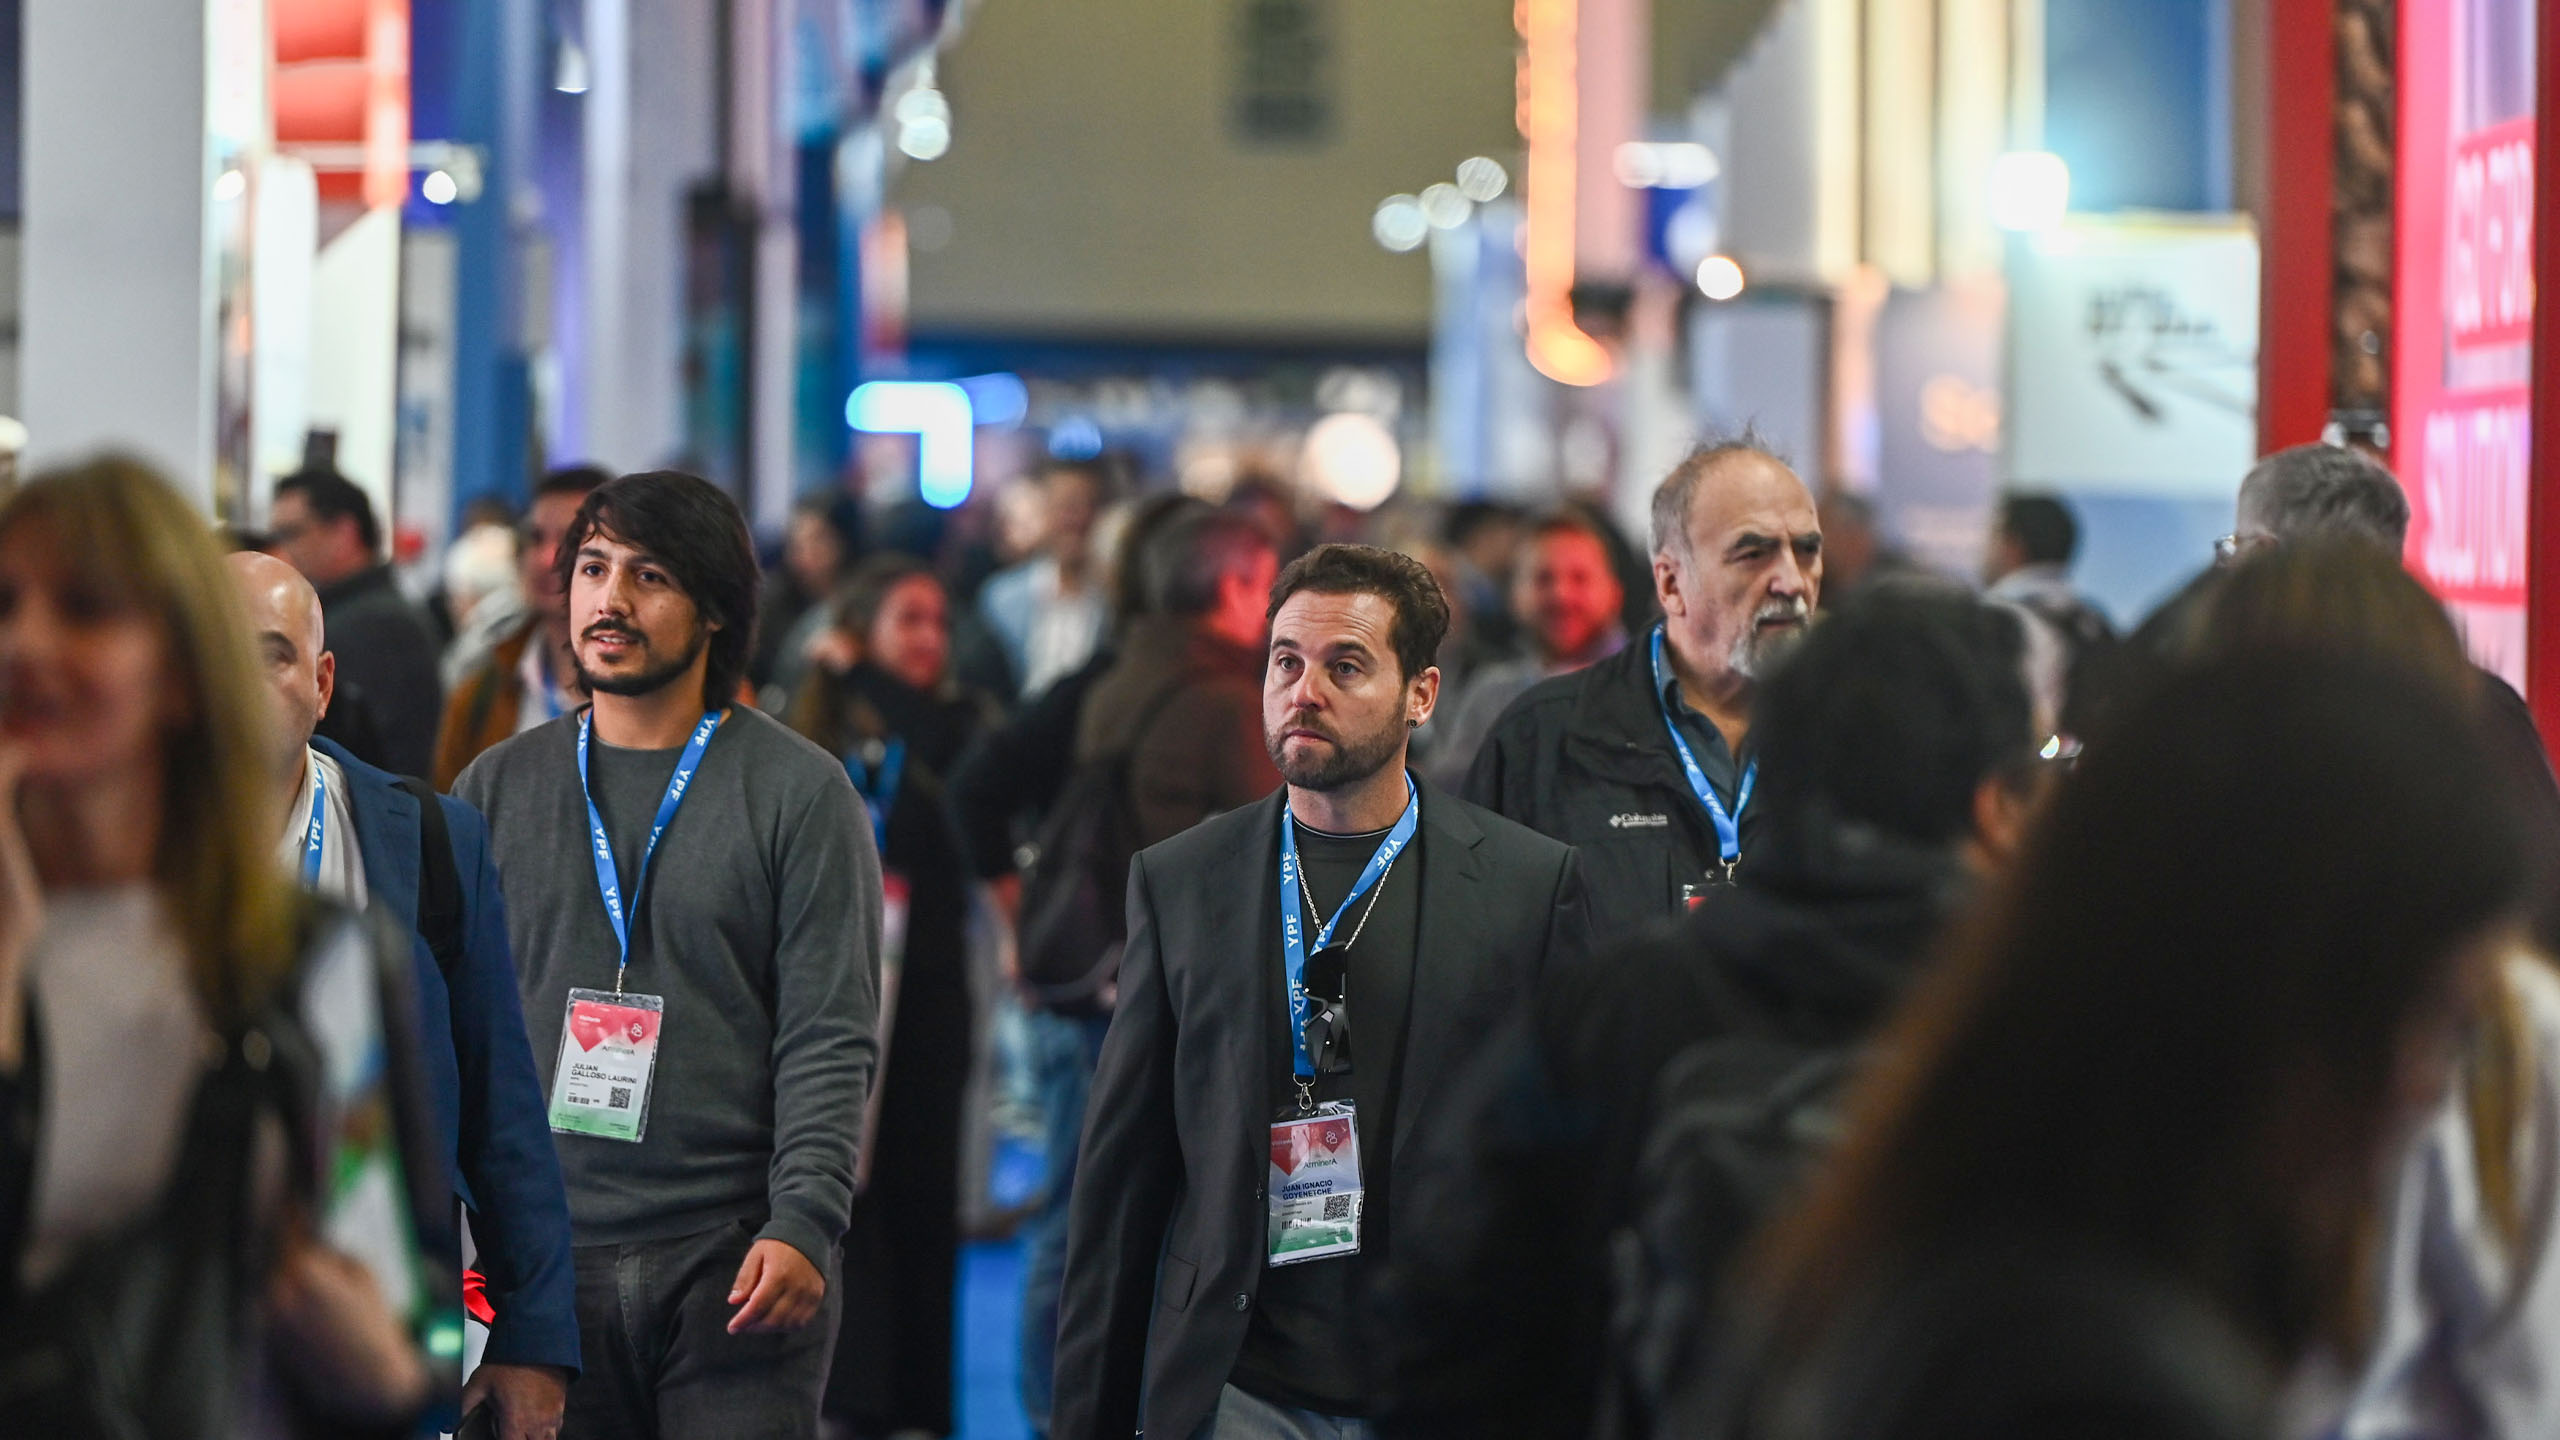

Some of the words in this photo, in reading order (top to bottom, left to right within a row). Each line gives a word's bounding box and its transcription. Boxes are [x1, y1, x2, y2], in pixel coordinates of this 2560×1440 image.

[694, 719, 716, 746] YPF
[671, 769, 691, 801] YPF
[309, 817, 322, 852] YPF
[595, 827, 609, 860] YPF
[1283, 851, 1294, 885] YPF
[1377, 838, 1402, 870] YPF
[605, 886, 622, 920] YPF
[1287, 913, 1299, 949] YPF
[1291, 978, 1304, 1016] YPF
[571, 1069, 607, 1080] GALLOSO
[607, 1074, 637, 1084] LAURINI
[572, 1063, 599, 1071] JULIAN
[1281, 1184, 1301, 1193] JUAN
[1302, 1179, 1333, 1190] IGNACIO
[1282, 1188, 1332, 1200] GOYENETCHE
